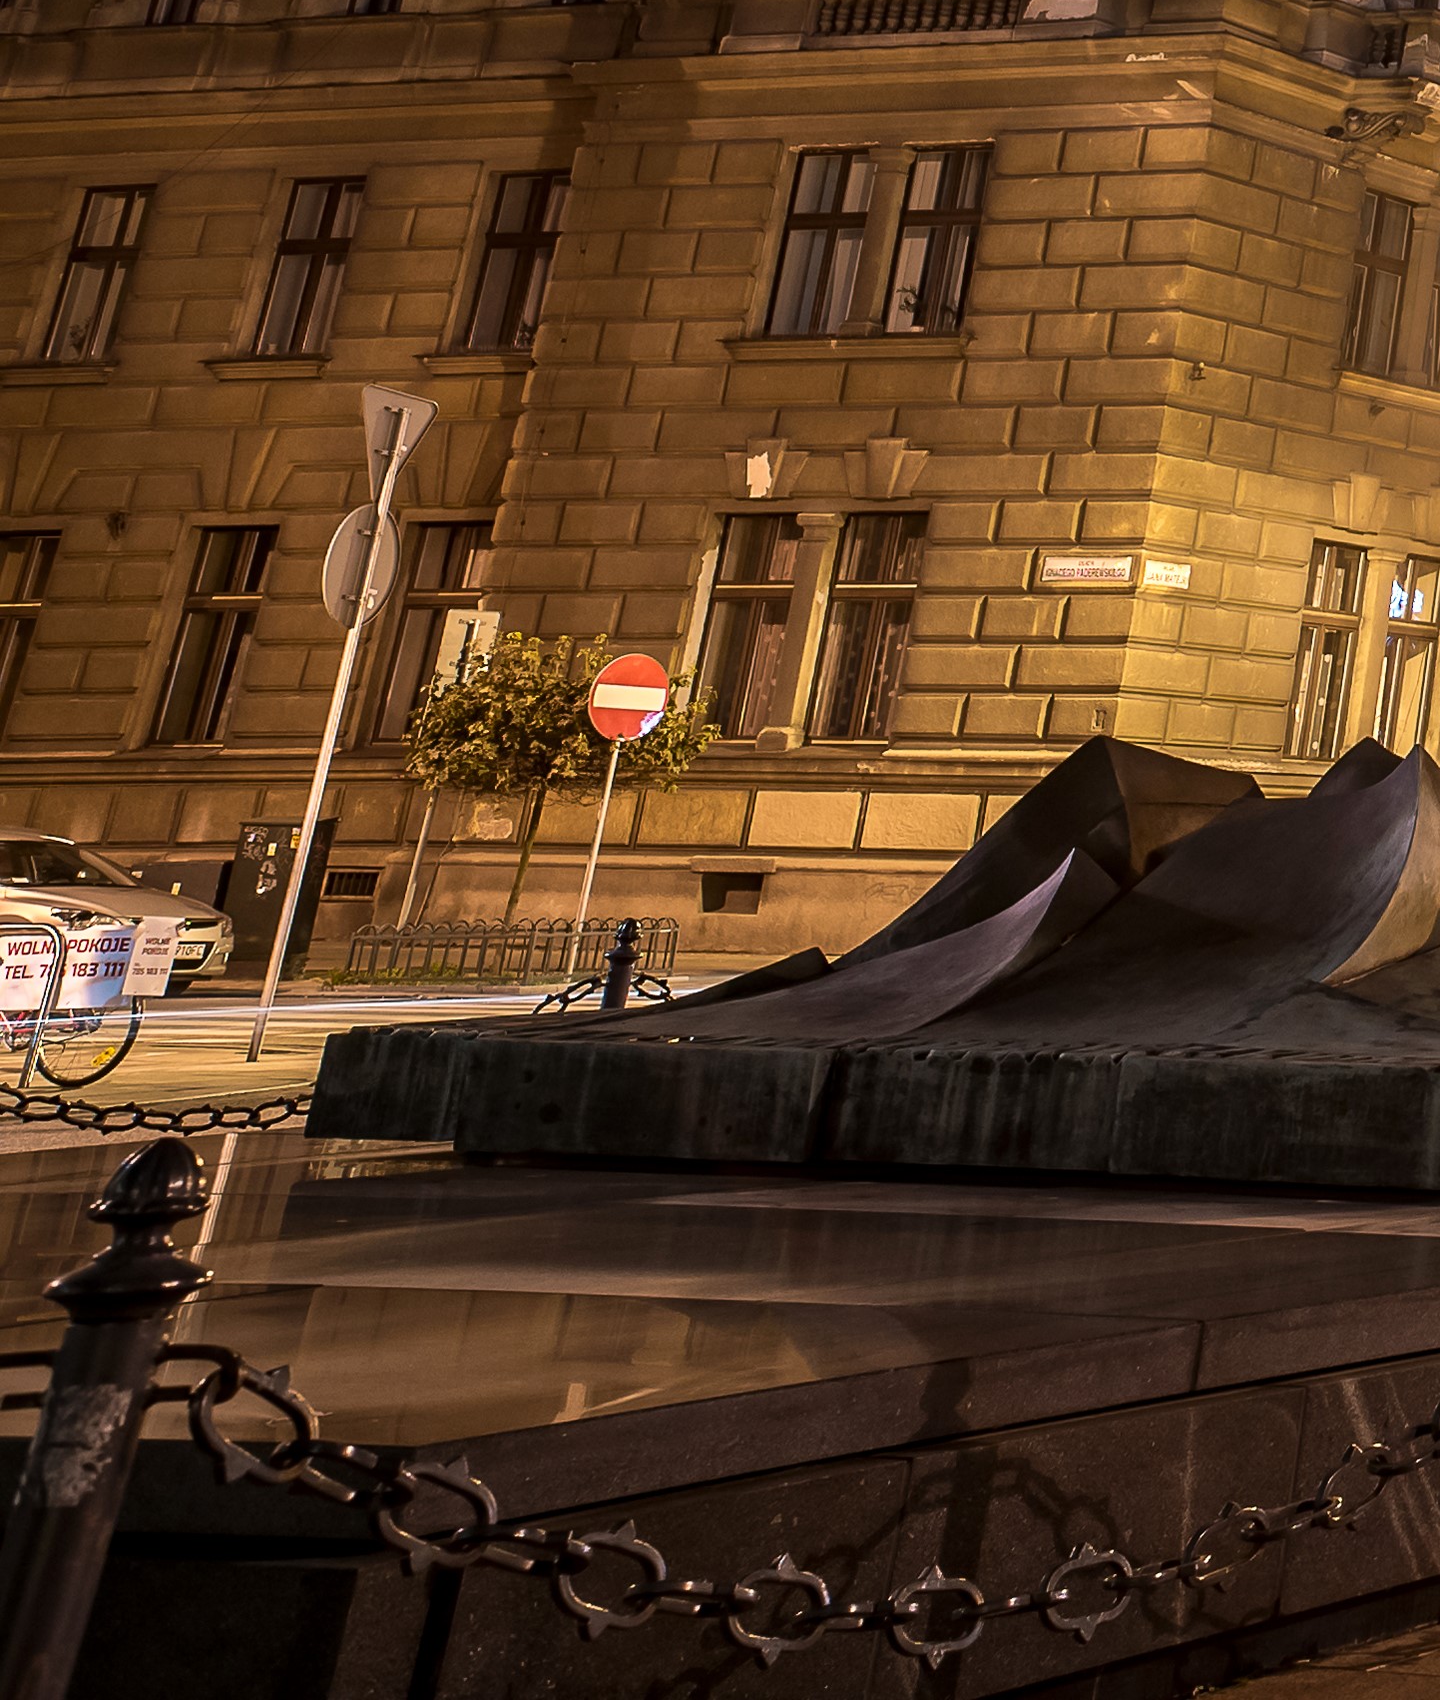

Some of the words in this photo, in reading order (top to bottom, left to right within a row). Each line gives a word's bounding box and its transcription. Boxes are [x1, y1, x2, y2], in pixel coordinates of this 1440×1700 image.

[7, 939, 56, 956] WOLN
[66, 937, 132, 954] POKOJE
[5, 964, 34, 980] TEL.
[72, 962, 100, 978] 183
[103, 961, 126, 977] 111
